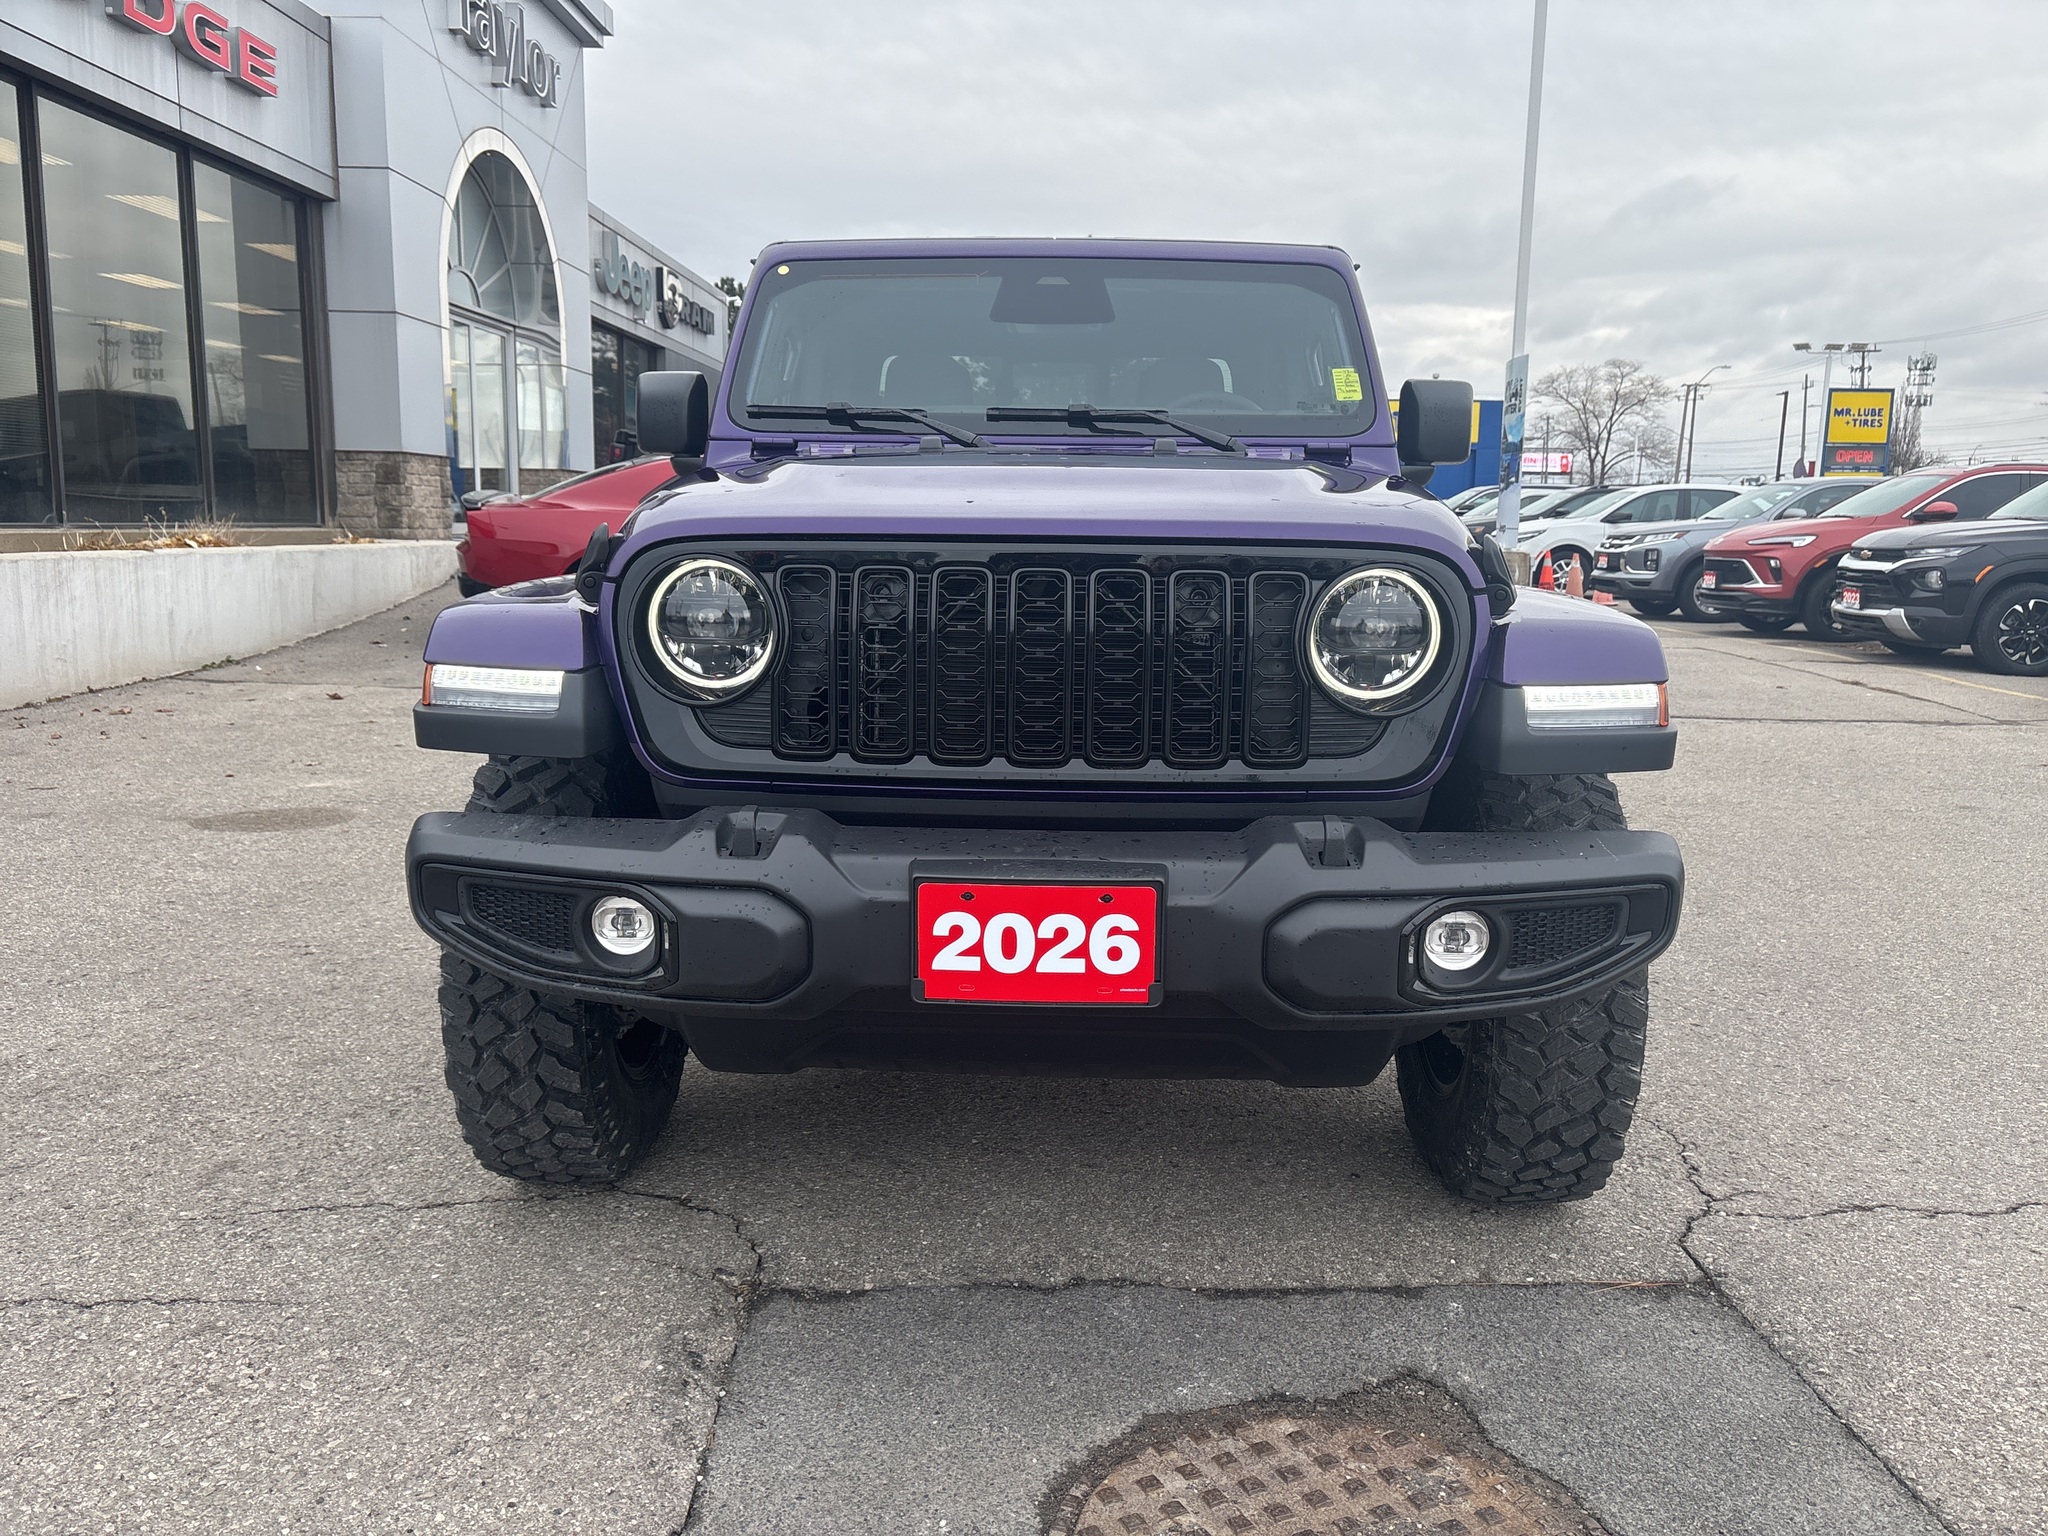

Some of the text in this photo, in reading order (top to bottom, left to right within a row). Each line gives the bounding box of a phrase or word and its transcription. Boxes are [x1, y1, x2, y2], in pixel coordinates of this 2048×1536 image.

[598, 231, 652, 321] Jeep
[679, 293, 715, 335] RAM
[1833, 407, 1884, 418] MR. LUBE
[1836, 449, 1874, 463] OPEN
[1842, 590, 1860, 605] 2023
[931, 911, 1141, 976] 2026
